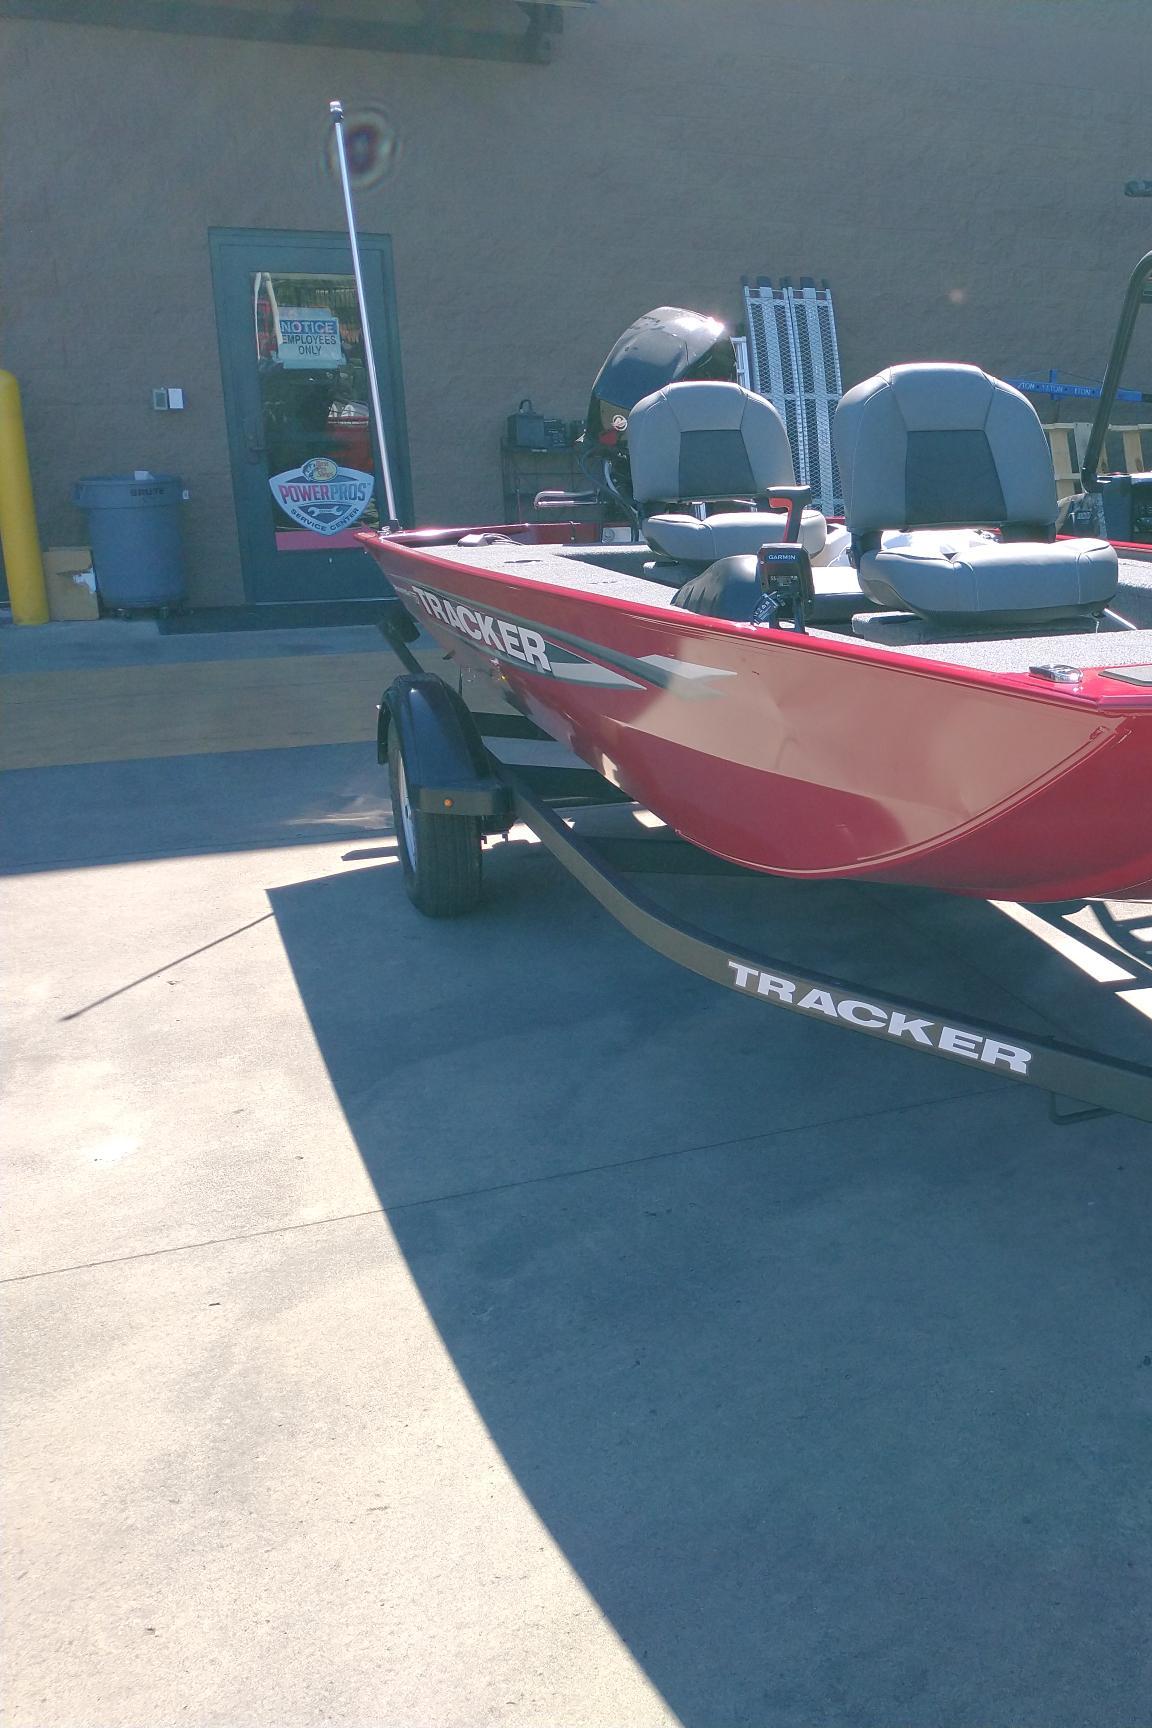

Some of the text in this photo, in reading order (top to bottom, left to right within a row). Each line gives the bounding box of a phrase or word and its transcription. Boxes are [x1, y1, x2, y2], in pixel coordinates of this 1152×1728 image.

[280, 321, 334, 334] NOTICE
[282, 334, 337, 345] EMPLOYEES
[298, 345, 322, 356] ONLY
[290, 507, 360, 532] SERVICE CENTER
[411, 585, 552, 673] TRACKER
[728, 960, 1032, 1074] TRACKER
